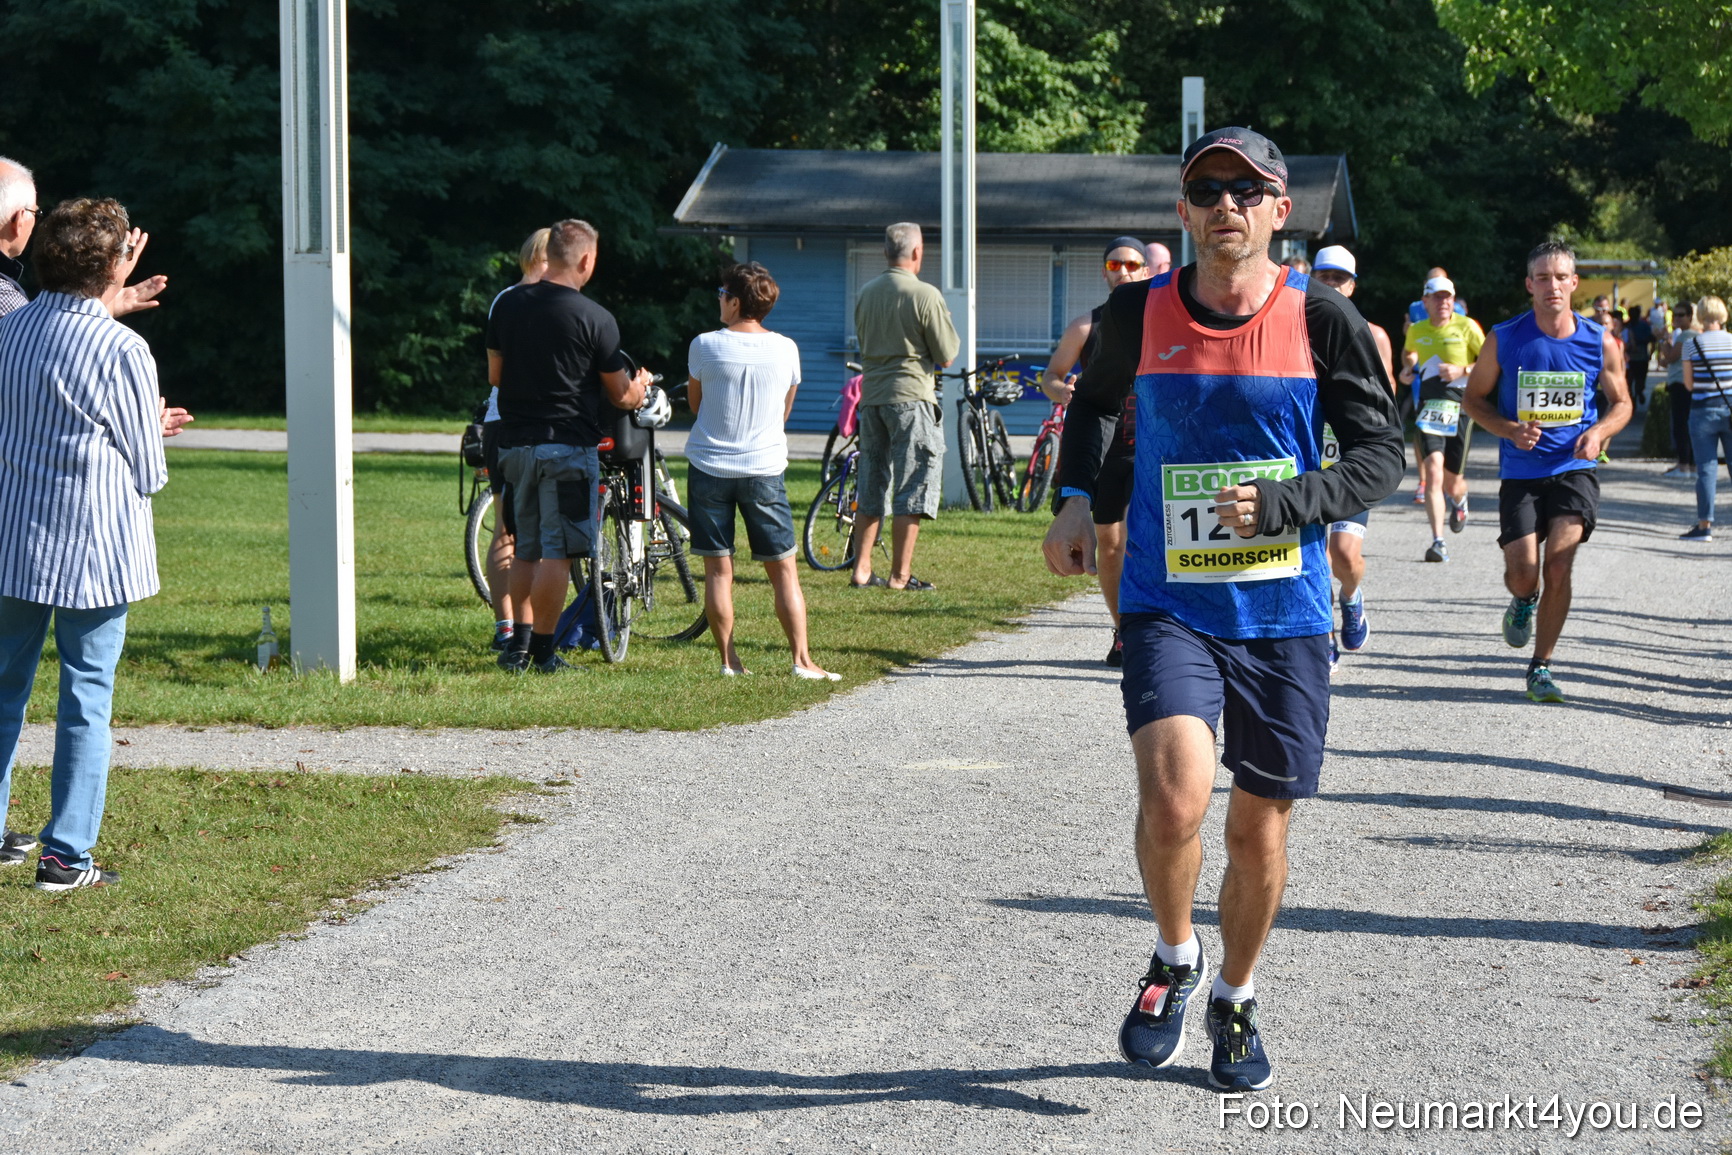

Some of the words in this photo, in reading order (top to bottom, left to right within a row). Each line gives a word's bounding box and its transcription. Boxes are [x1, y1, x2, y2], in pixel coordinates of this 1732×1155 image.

[1523, 374, 1579, 387] BOCK
[1526, 391, 1576, 407] 1348
[1179, 548, 1288, 567] SCHORSCHI
